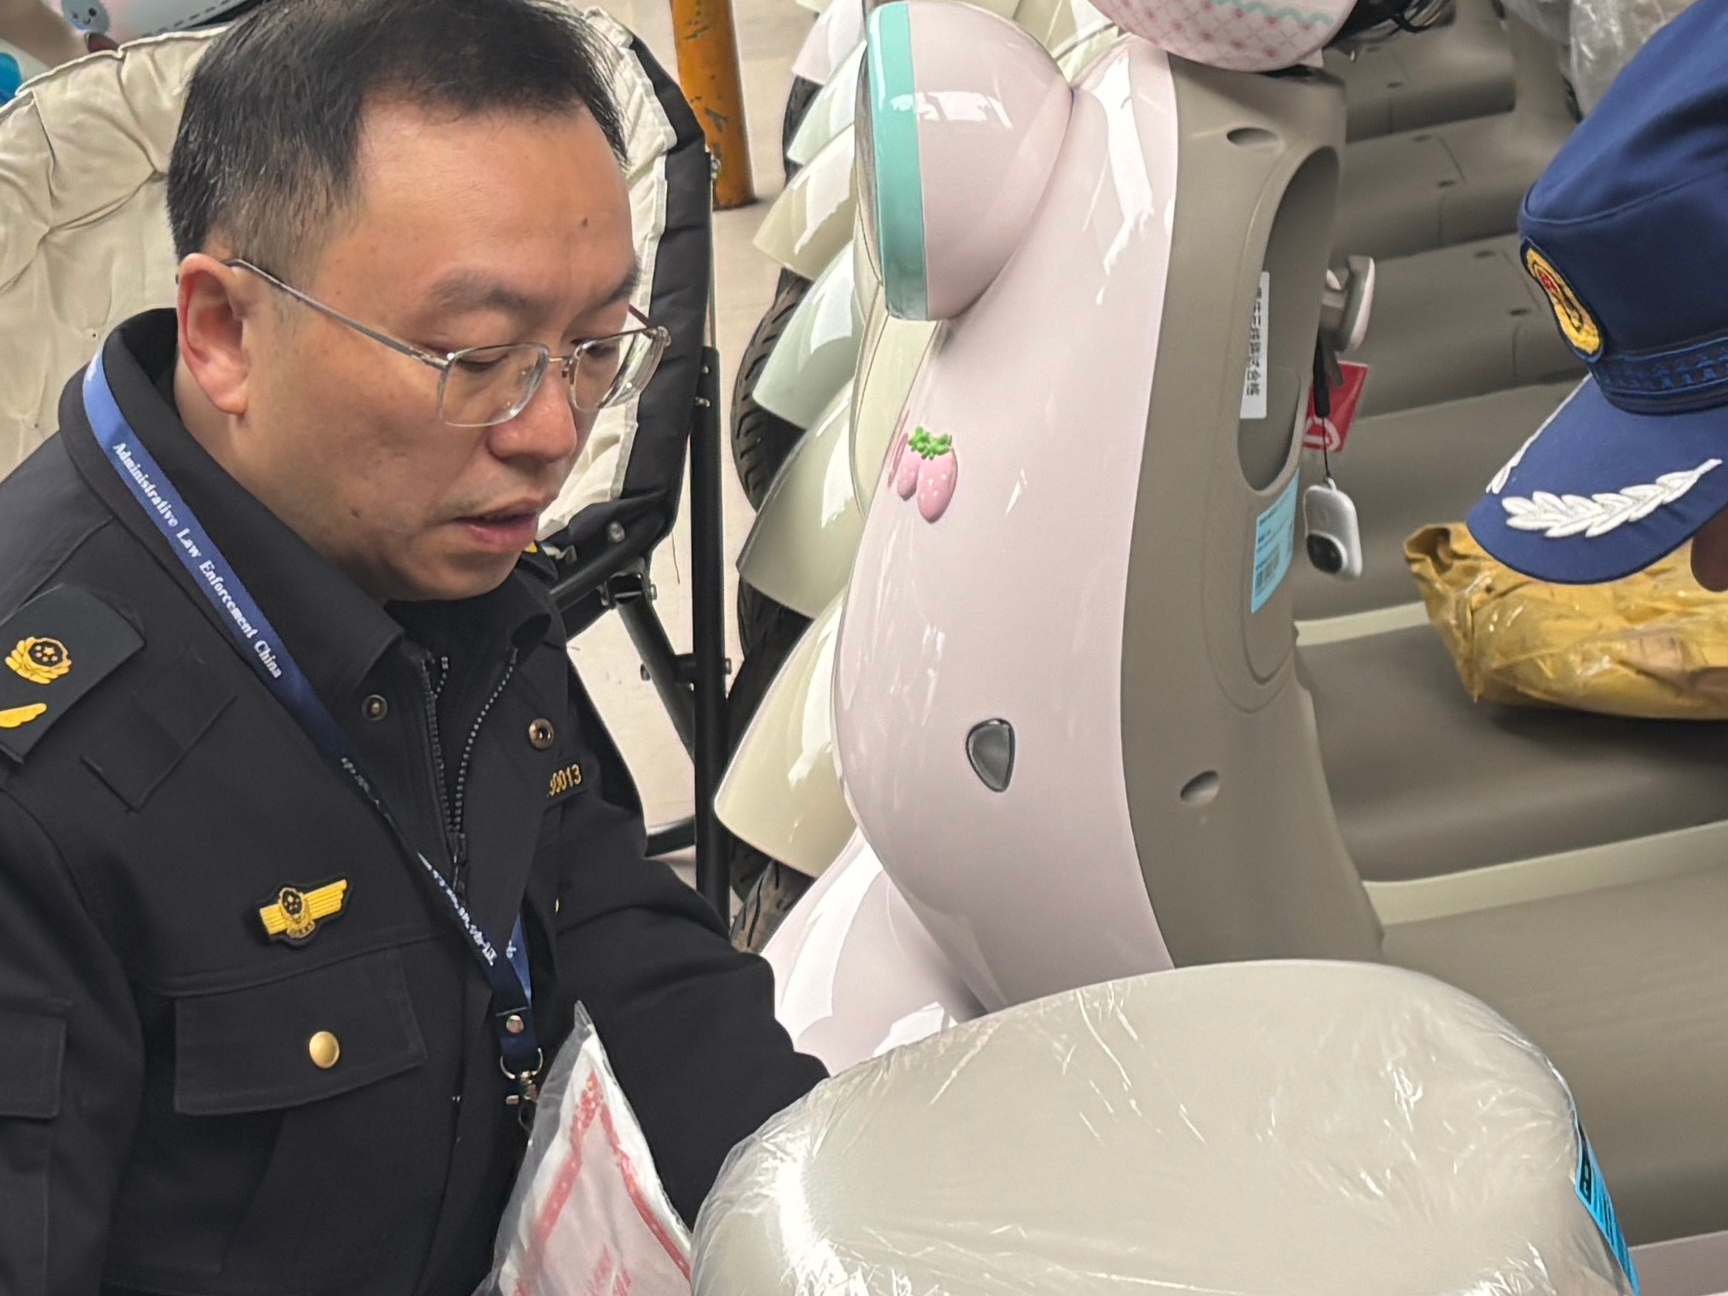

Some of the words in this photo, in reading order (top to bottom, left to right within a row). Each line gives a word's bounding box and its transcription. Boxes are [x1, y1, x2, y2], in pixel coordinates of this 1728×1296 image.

[112, 440, 181, 529] Administrative
[175, 527, 202, 560] Law
[198, 559, 259, 639] Enforcement
[252, 638, 284, 679] China
